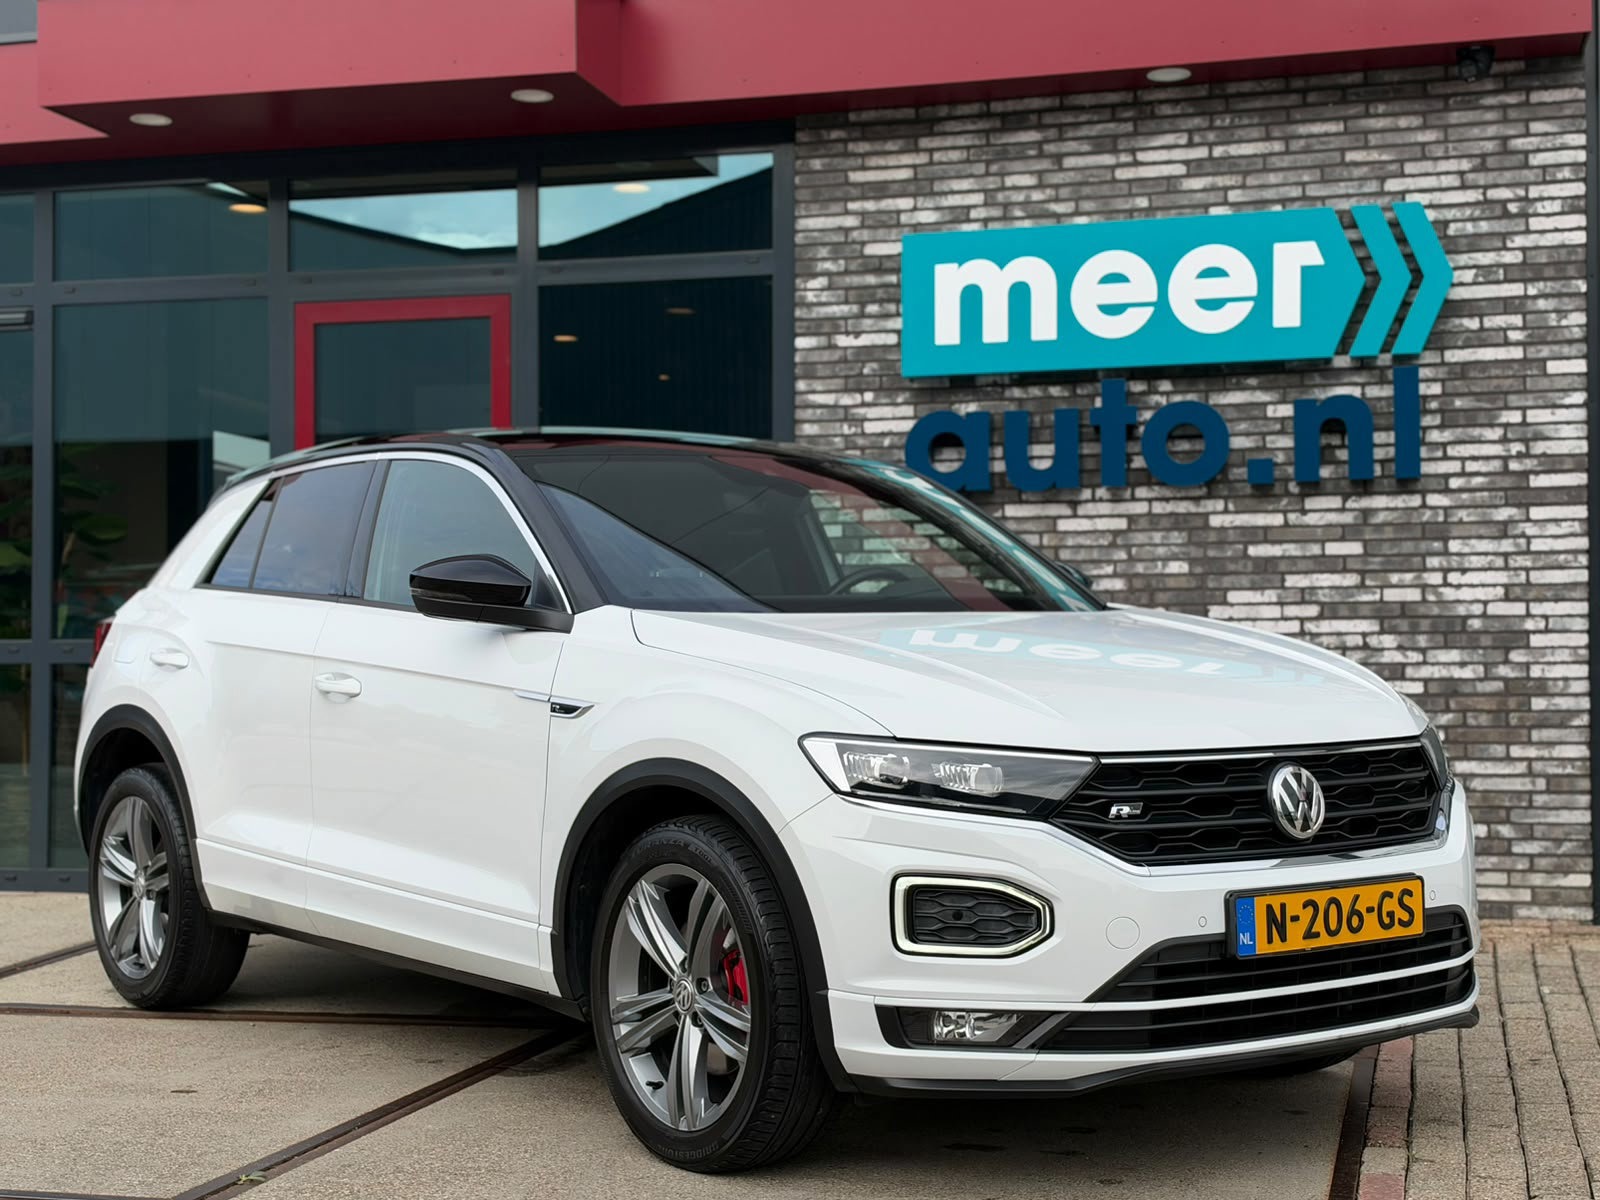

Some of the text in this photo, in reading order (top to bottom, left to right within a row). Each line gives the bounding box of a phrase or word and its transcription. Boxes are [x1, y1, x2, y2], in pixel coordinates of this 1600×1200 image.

[934, 240, 1325, 346] meer
[905, 365, 1421, 491] auto.nl
[1239, 932, 1254, 946] NL
[1265, 888, 1415, 945] N-206-GS
